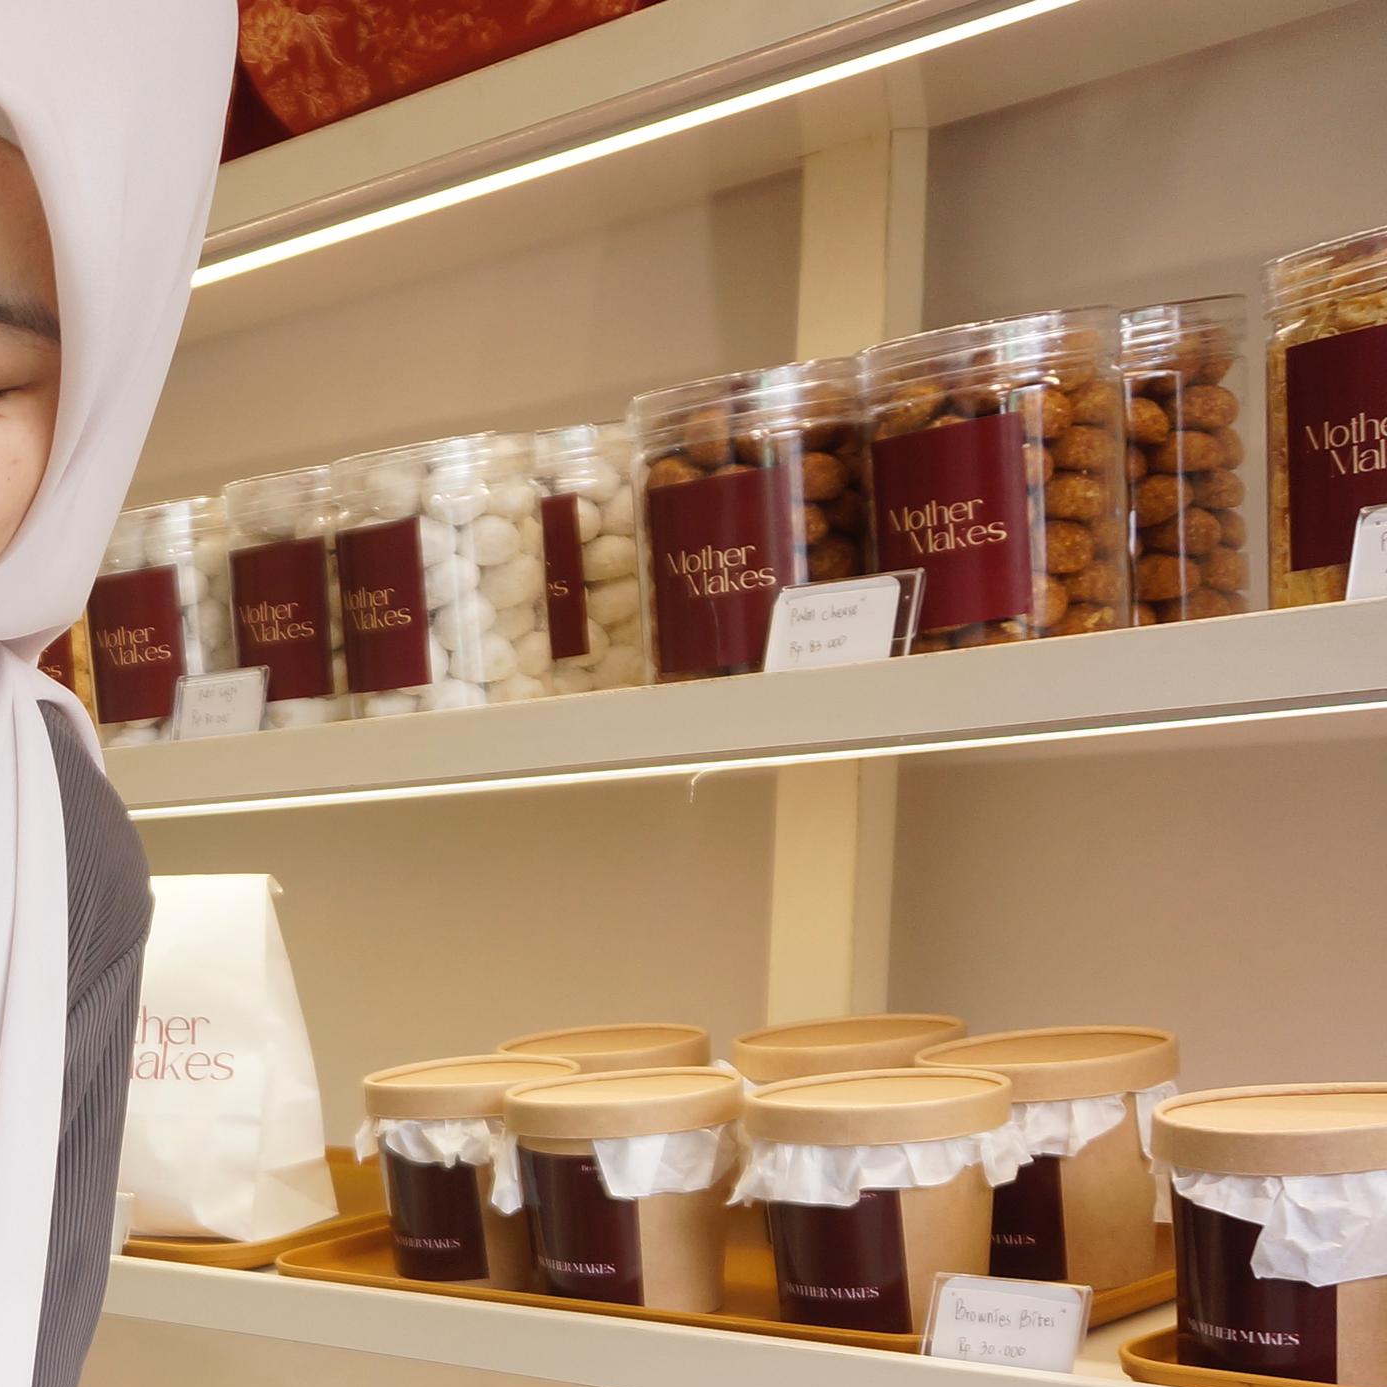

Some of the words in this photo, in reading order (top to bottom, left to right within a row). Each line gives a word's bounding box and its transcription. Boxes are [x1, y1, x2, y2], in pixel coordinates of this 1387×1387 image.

[889, 497, 985, 532] Mother
[909, 520, 1008, 554] Makes
[666, 544, 756, 575] Mother
[686, 566, 777, 596] Makes
[238, 600, 299, 625] Mother
[352, 606, 413, 631] Makes
[95, 625, 156, 649] Mother
[249, 619, 316, 643] Makes
[108, 642, 173, 666] Makes
[136, 1005, 211, 1045] her
[130, 1040, 235, 1081] akes
[422, 1237, 461, 1249] MAKES
[573, 1262, 617, 1275] MAKES
[830, 1286, 880, 1299] MAKES
[1239, 1329, 1301, 1346] MAKES
